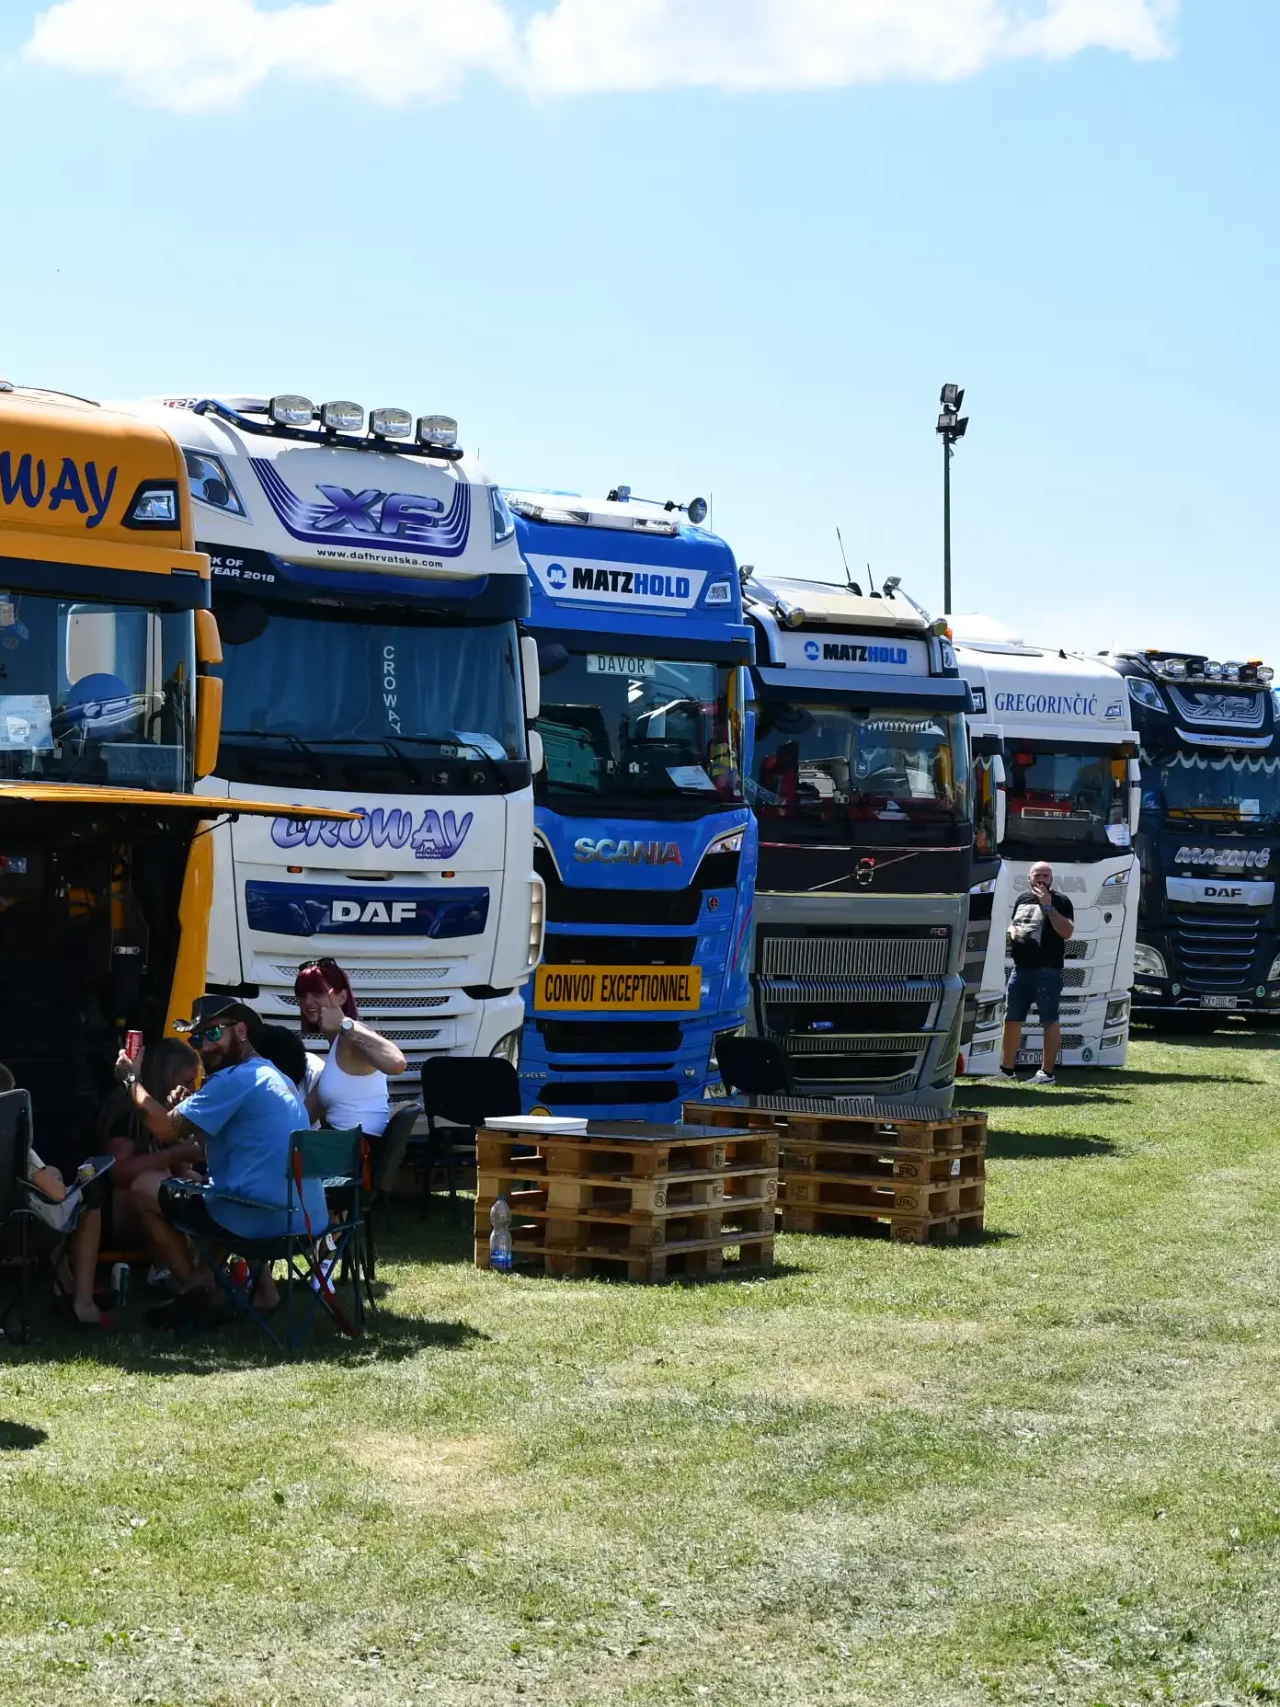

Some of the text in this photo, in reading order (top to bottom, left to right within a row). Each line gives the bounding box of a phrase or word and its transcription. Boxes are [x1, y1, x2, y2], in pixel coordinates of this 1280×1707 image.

[226, 558, 244, 568] OF
[316, 548, 444, 569] www.dafhrvatska.com
[243, 570, 275, 583] 2018
[572, 567, 690, 599] MATZHOLD
[823, 643, 908, 664] MATZHOLD
[598, 655, 646, 675] DAVOR
[382, 646, 402, 735] CROWAY
[994, 692, 1098, 716] GREGORINČIĆ
[574, 838, 683, 865] SCANIA
[1204, 887, 1243, 898] DAF
[331, 900, 417, 924] DAF
[544, 973, 691, 1003] CONVOI EXCEPTIONNEL
